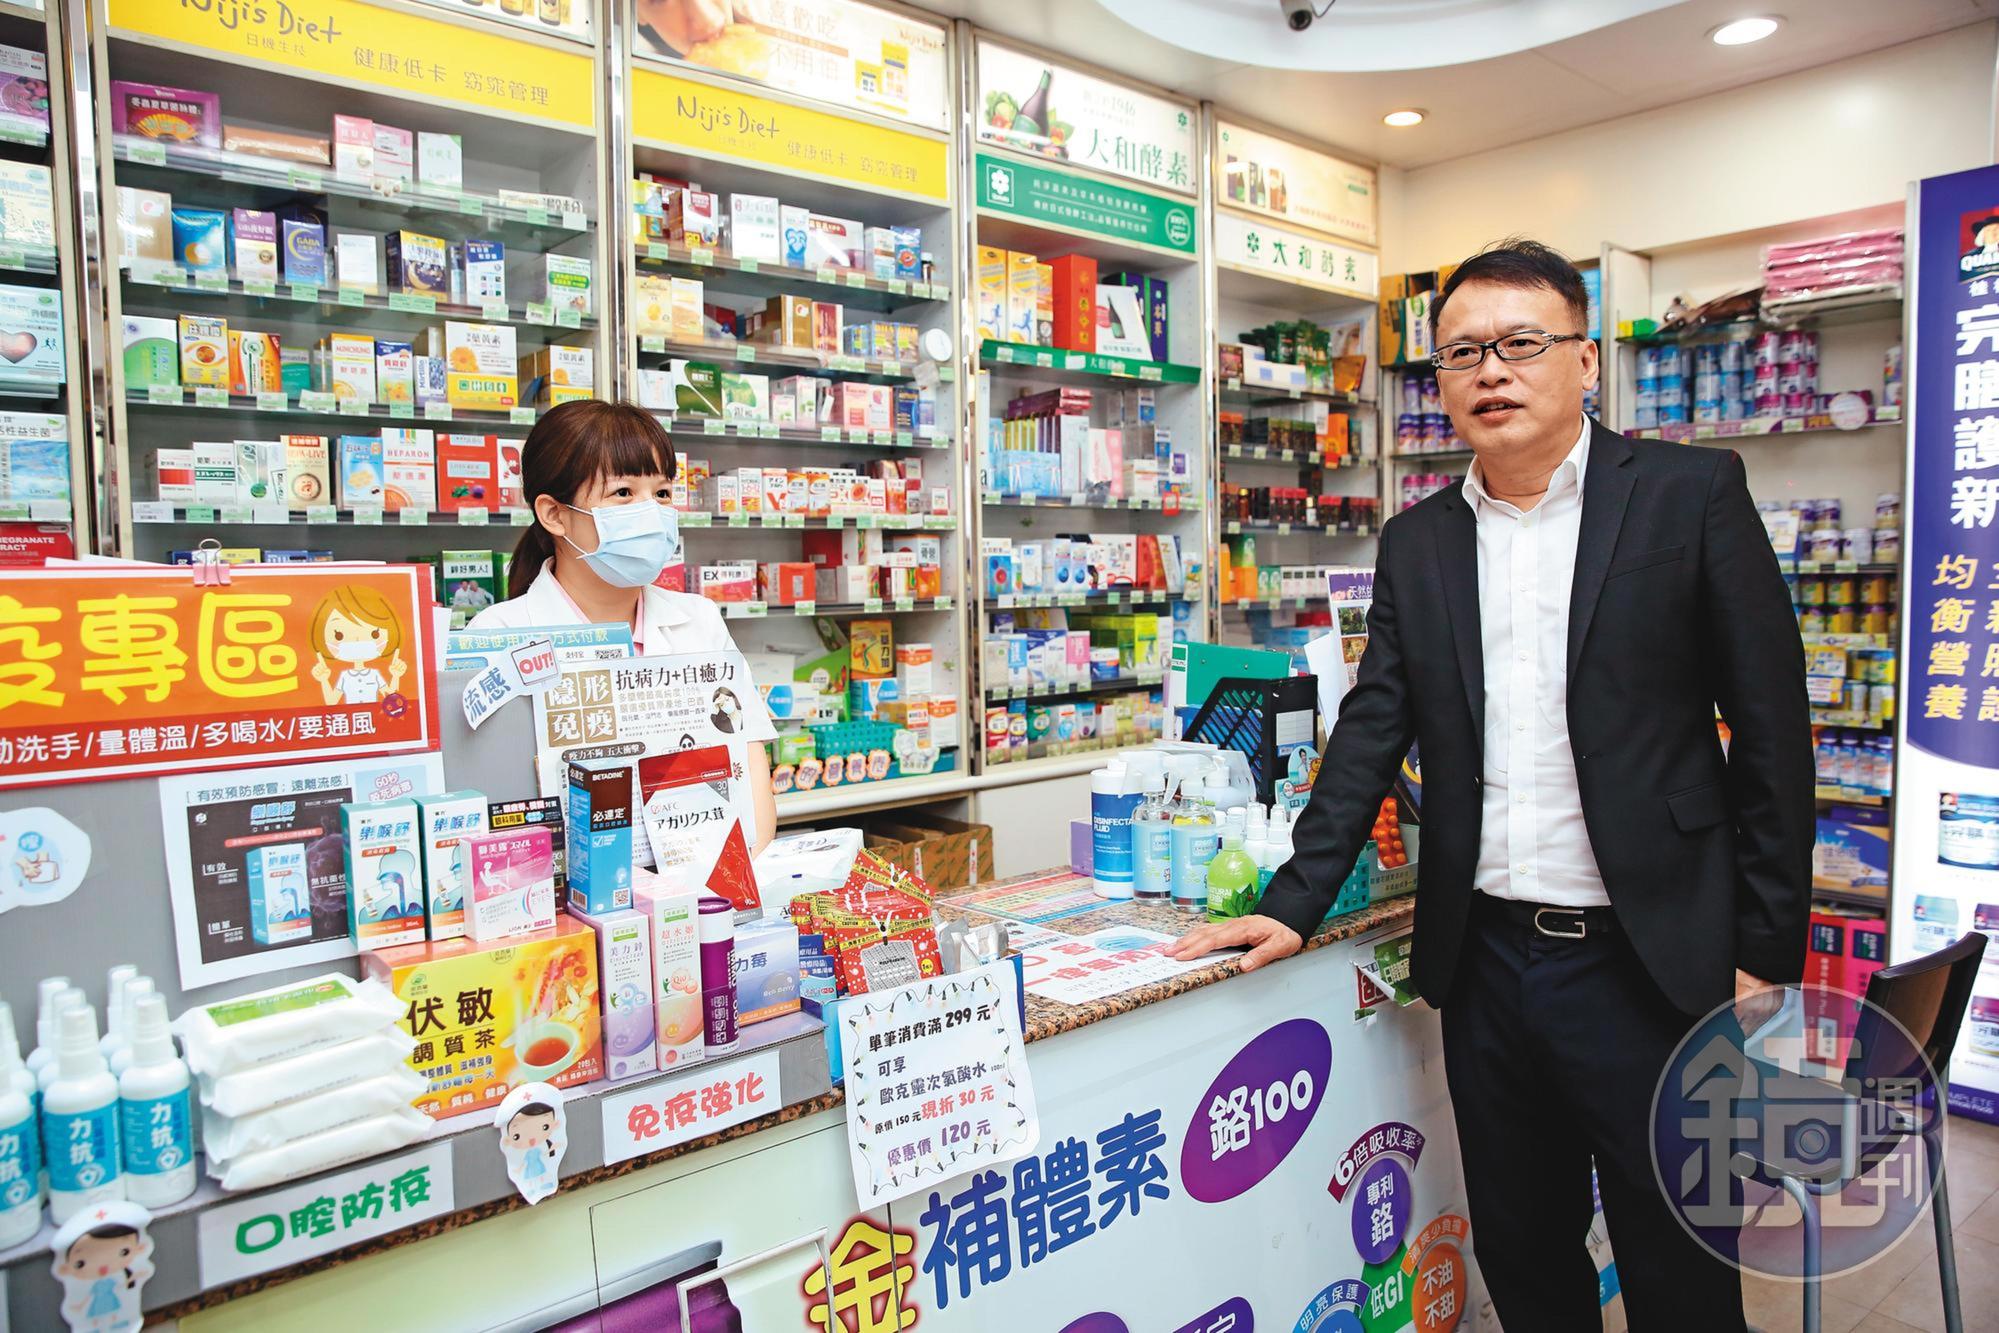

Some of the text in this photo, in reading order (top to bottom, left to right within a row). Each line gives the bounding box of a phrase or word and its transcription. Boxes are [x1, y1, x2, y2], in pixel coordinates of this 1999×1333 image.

[276, 0, 341, 43] Diet
[353, 47, 550, 106] 健康低卡 窈窕管理
[677, 96, 780, 138] Niji's Diet
[787, 140, 849, 168] 健康低卡
[1087, 129, 1189, 187] 大和酵素
[295, 236, 321, 248] GABA
[1273, 240, 1357, 282] 大和酵素
[387, 449, 430, 458] HEPARON
[703, 569, 719, 581] EX
[1925, 554, 1978, 721] 均衡營養
[519, 652, 554, 675] OUT!
[616, 662, 735, 691] 抗病力+自癒力
[464, 666, 512, 722] 流感
[546, 673, 611, 707] 隱形
[551, 710, 616, 744] 免疫
[375, 772, 399, 788] 60秒
[592, 771, 624, 781] BETADINE
[359, 821, 411, 841] 樂喉舒
[433, 812, 481, 833] 樂喉舒
[592, 808, 625, 823] 必達定
[654, 807, 725, 831] アガリクス茸
[206, 862, 227, 873] 有效
[407, 987, 495, 1036] 伏敏
[869, 1004, 991, 1053] 單筆消費滿 299 元
[413, 1028, 495, 1064] 調質茶
[878, 1055, 906, 1077] 可享
[879, 1061, 987, 1105] 歐克靈次氯酸水
[150, 1102, 175, 1147] 力抗
[626, 1071, 766, 1141] 免疫強化
[875, 1084, 995, 1134] 原價 150 元 現折 30 元
[1208, 1068, 1314, 1160] 鉻100
[0, 1133, 23, 1182] 力抗
[69, 1117, 95, 1166] 力抗
[887, 1119, 991, 1167] 優惠價 120 元
[235, 1165, 431, 1255] 口腔防疫
[1366, 1172, 1394, 1206] 專利
[803, 1109, 1170, 1333] 金 補體素
[1370, 1203, 1395, 1248] 鉻
[1370, 1270, 1404, 1320] 低GI
[1422, 1257, 1454, 1296] 不油
[1299, 1282, 1360, 1332] 明亮保護
[1424, 1289, 1455, 1329] 不甜
